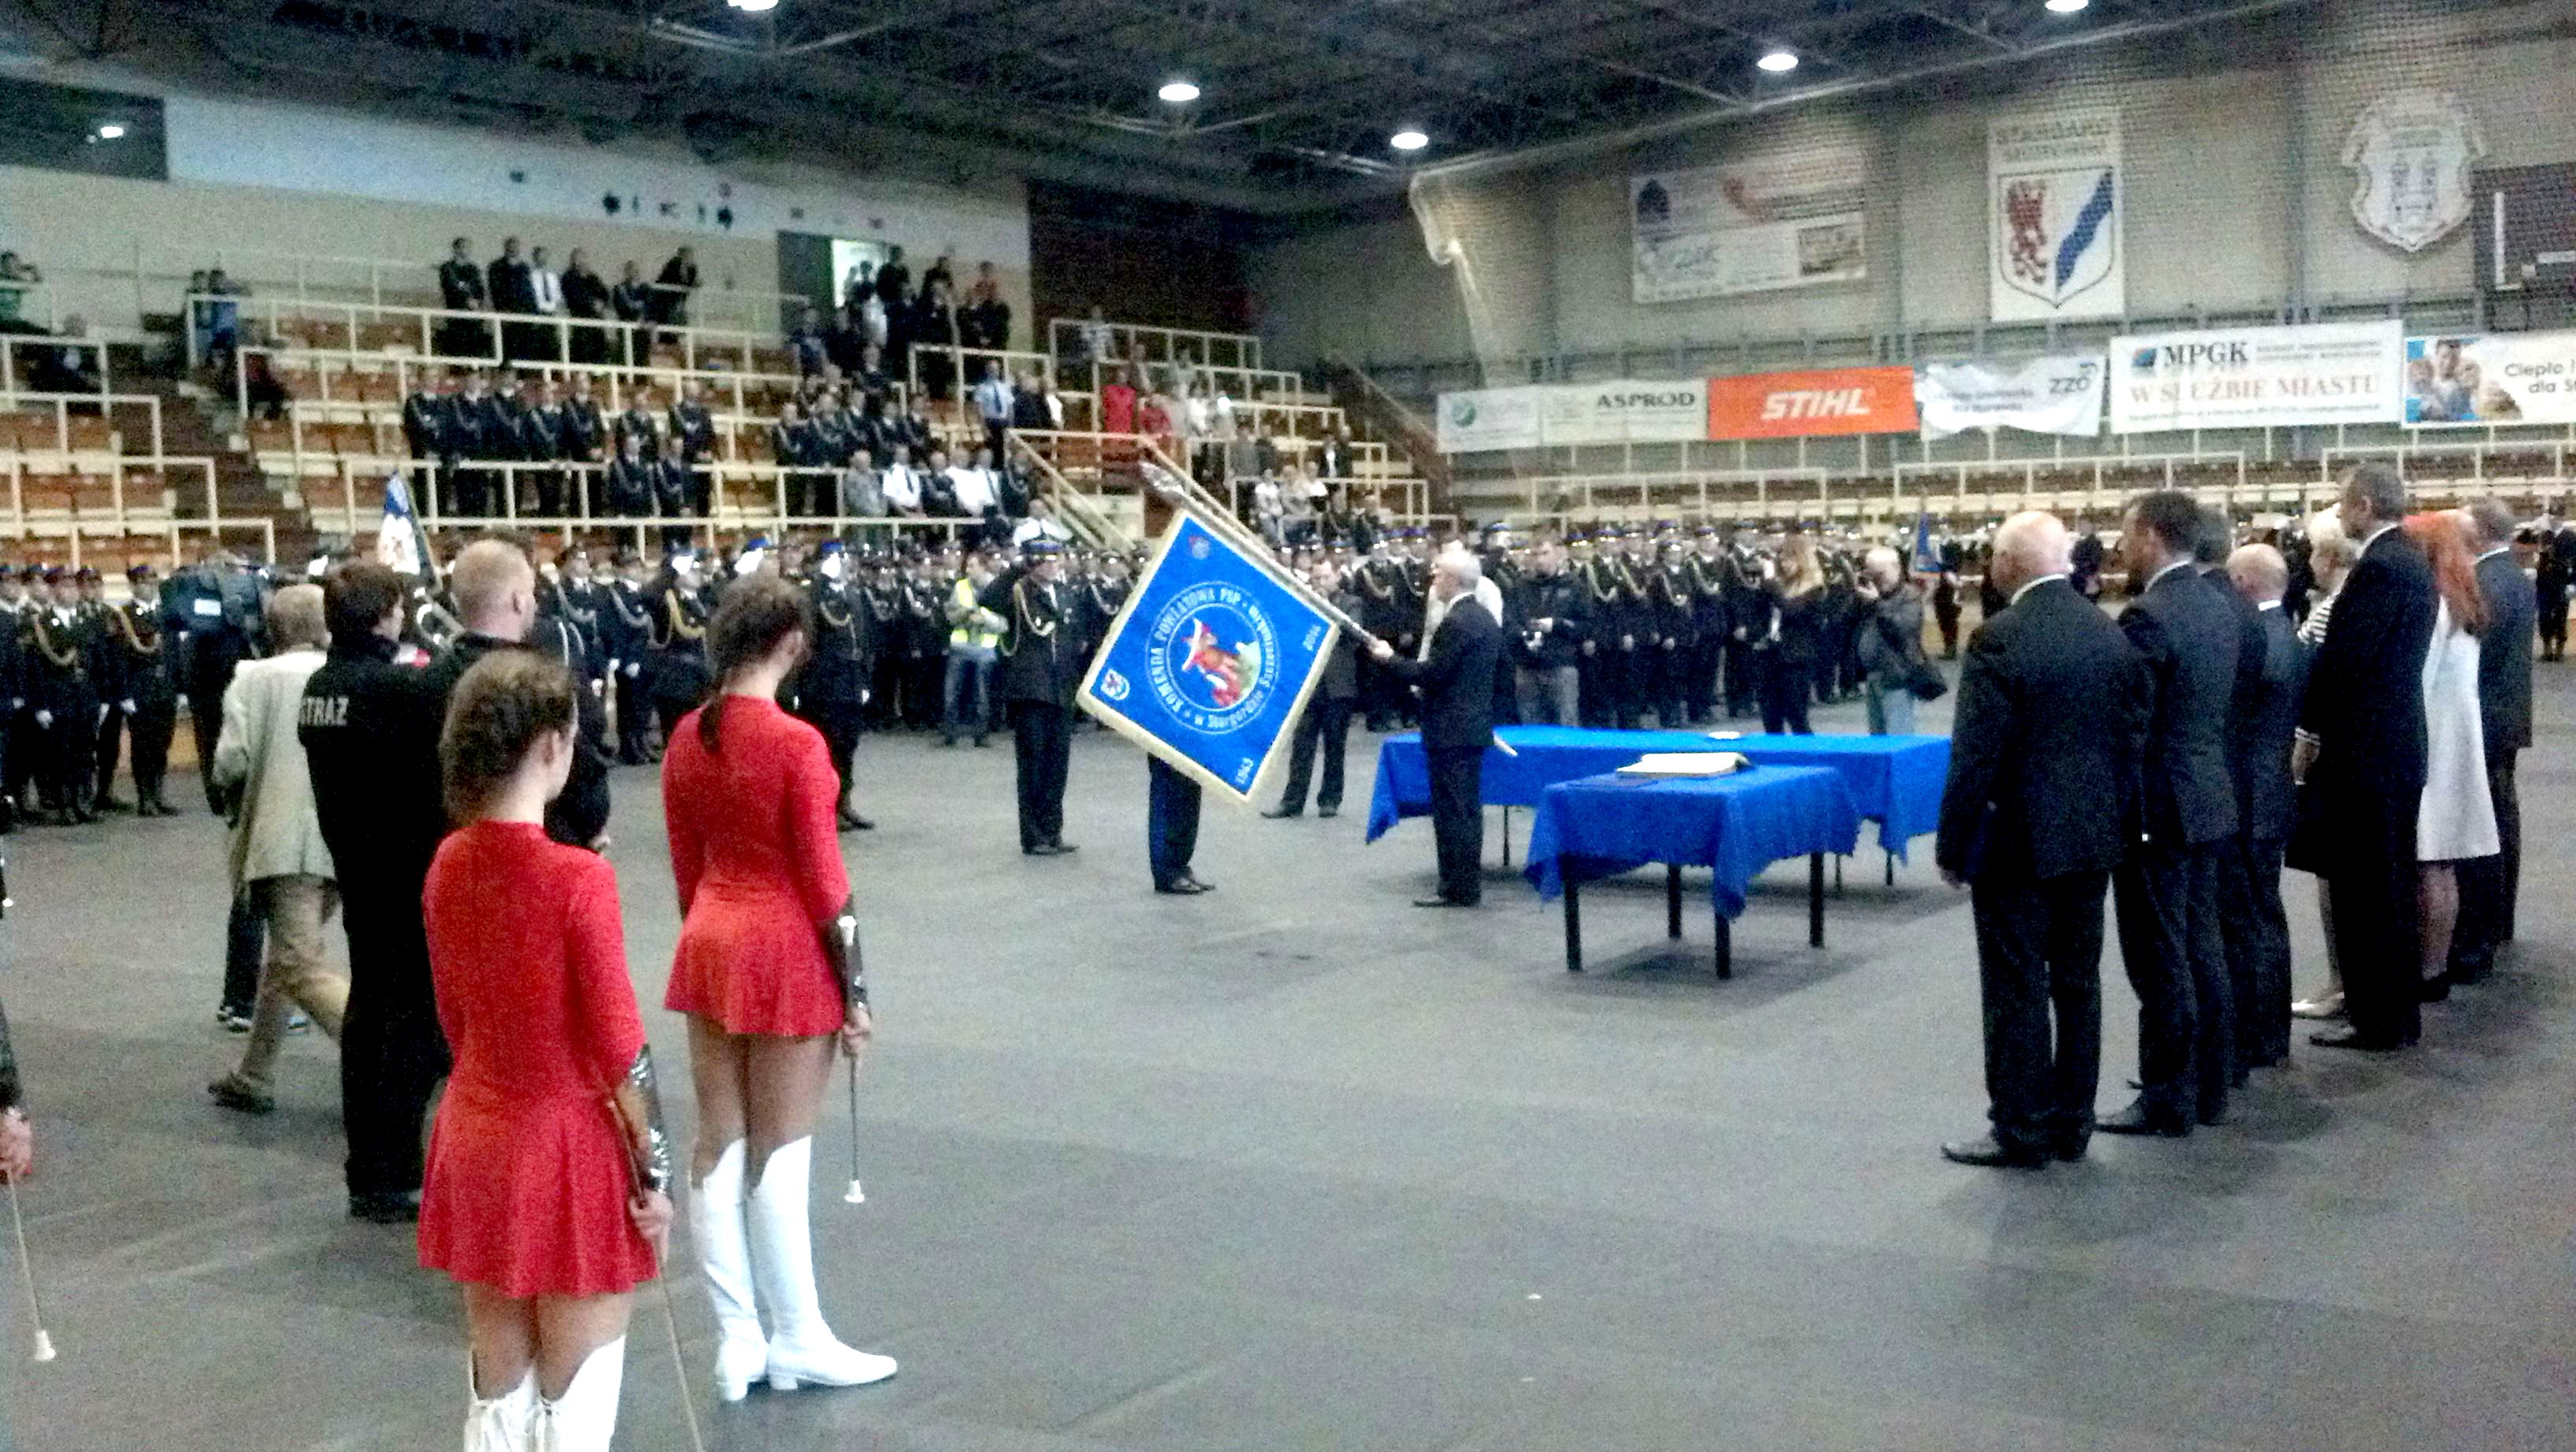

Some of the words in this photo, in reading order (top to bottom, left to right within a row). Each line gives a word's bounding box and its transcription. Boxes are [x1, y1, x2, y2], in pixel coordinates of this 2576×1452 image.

[2164, 341, 2249, 368] MPGK
[1597, 392, 1695, 409] ASPROD
[2131, 384, 2151, 403] W
[2276, 373, 2379, 399] MIASTU
[1760, 388, 1870, 421] STIHL
[1150, 647, 1185, 713] KOMENDA
